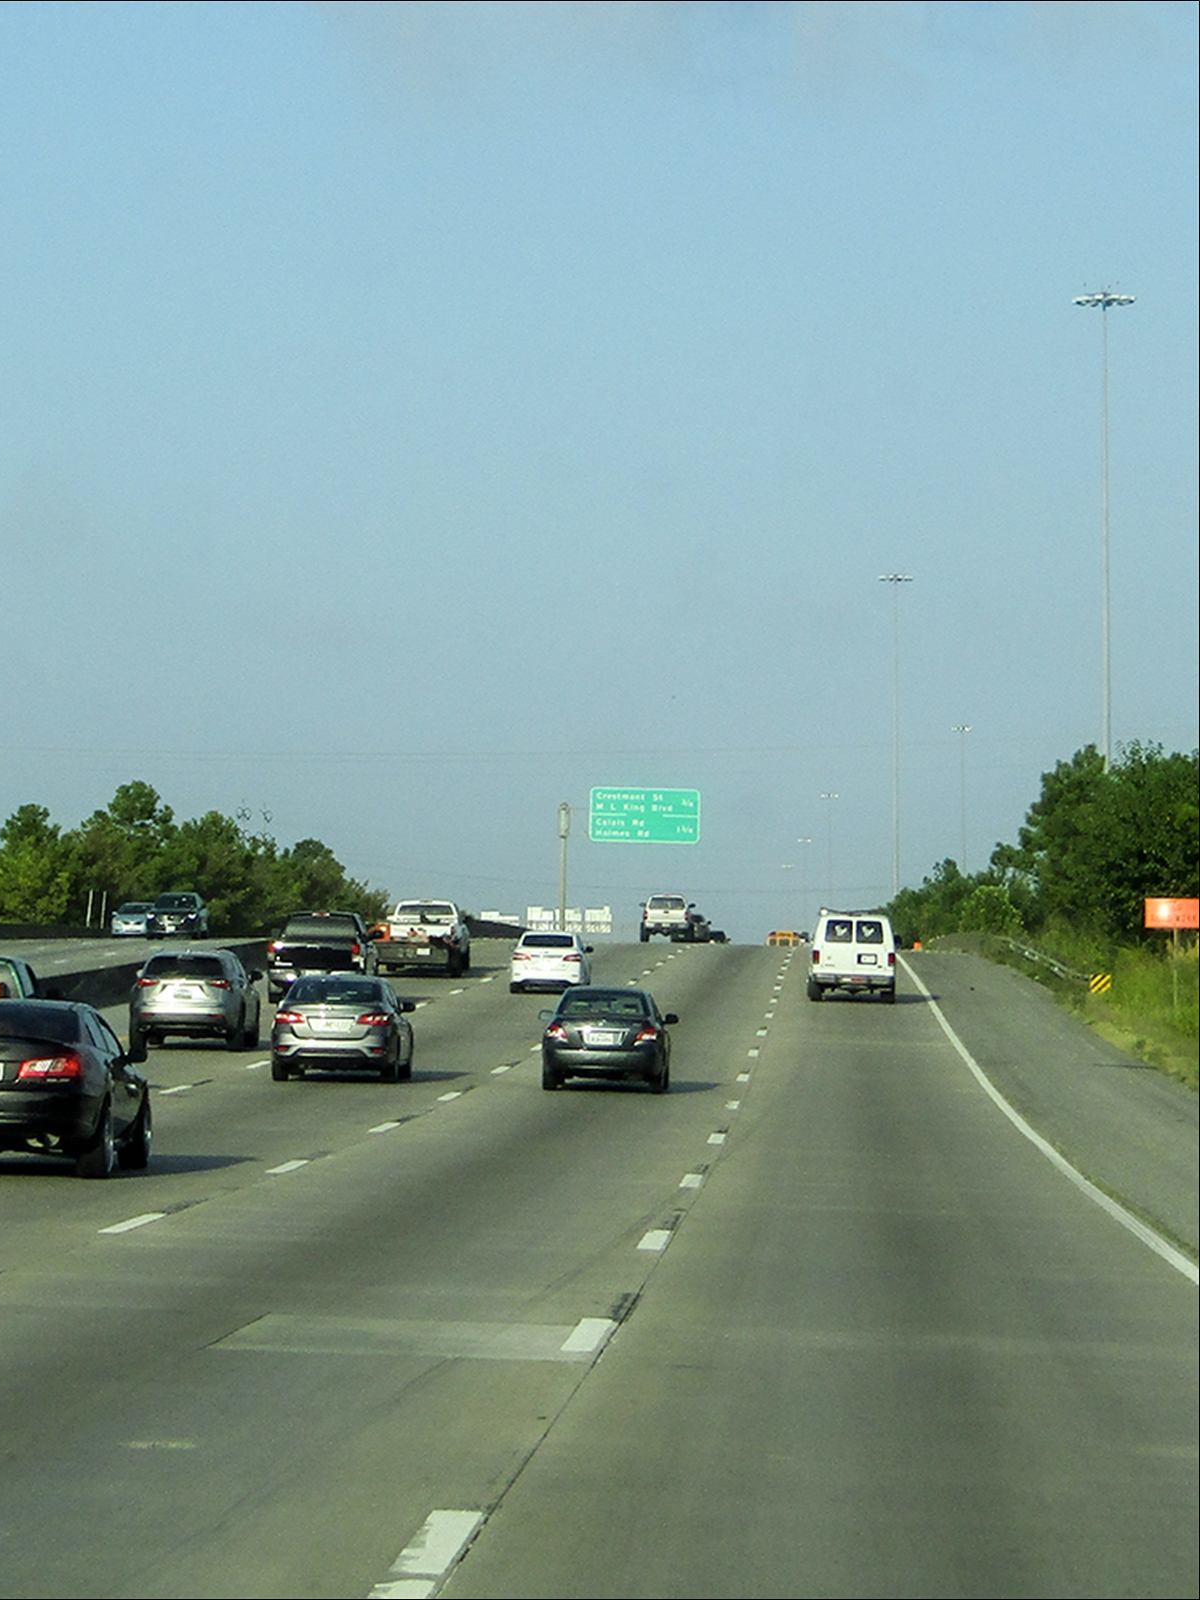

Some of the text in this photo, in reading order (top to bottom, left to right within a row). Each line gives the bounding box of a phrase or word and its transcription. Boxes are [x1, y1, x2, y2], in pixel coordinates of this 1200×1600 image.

[596, 792, 663, 801] Crestmont St
[610, 803, 616, 811] L
[623, 804, 645, 812] King
[652, 804, 673, 812] Blvd
[632, 819, 644, 827] Rd
[637, 830, 649, 838] Rd
